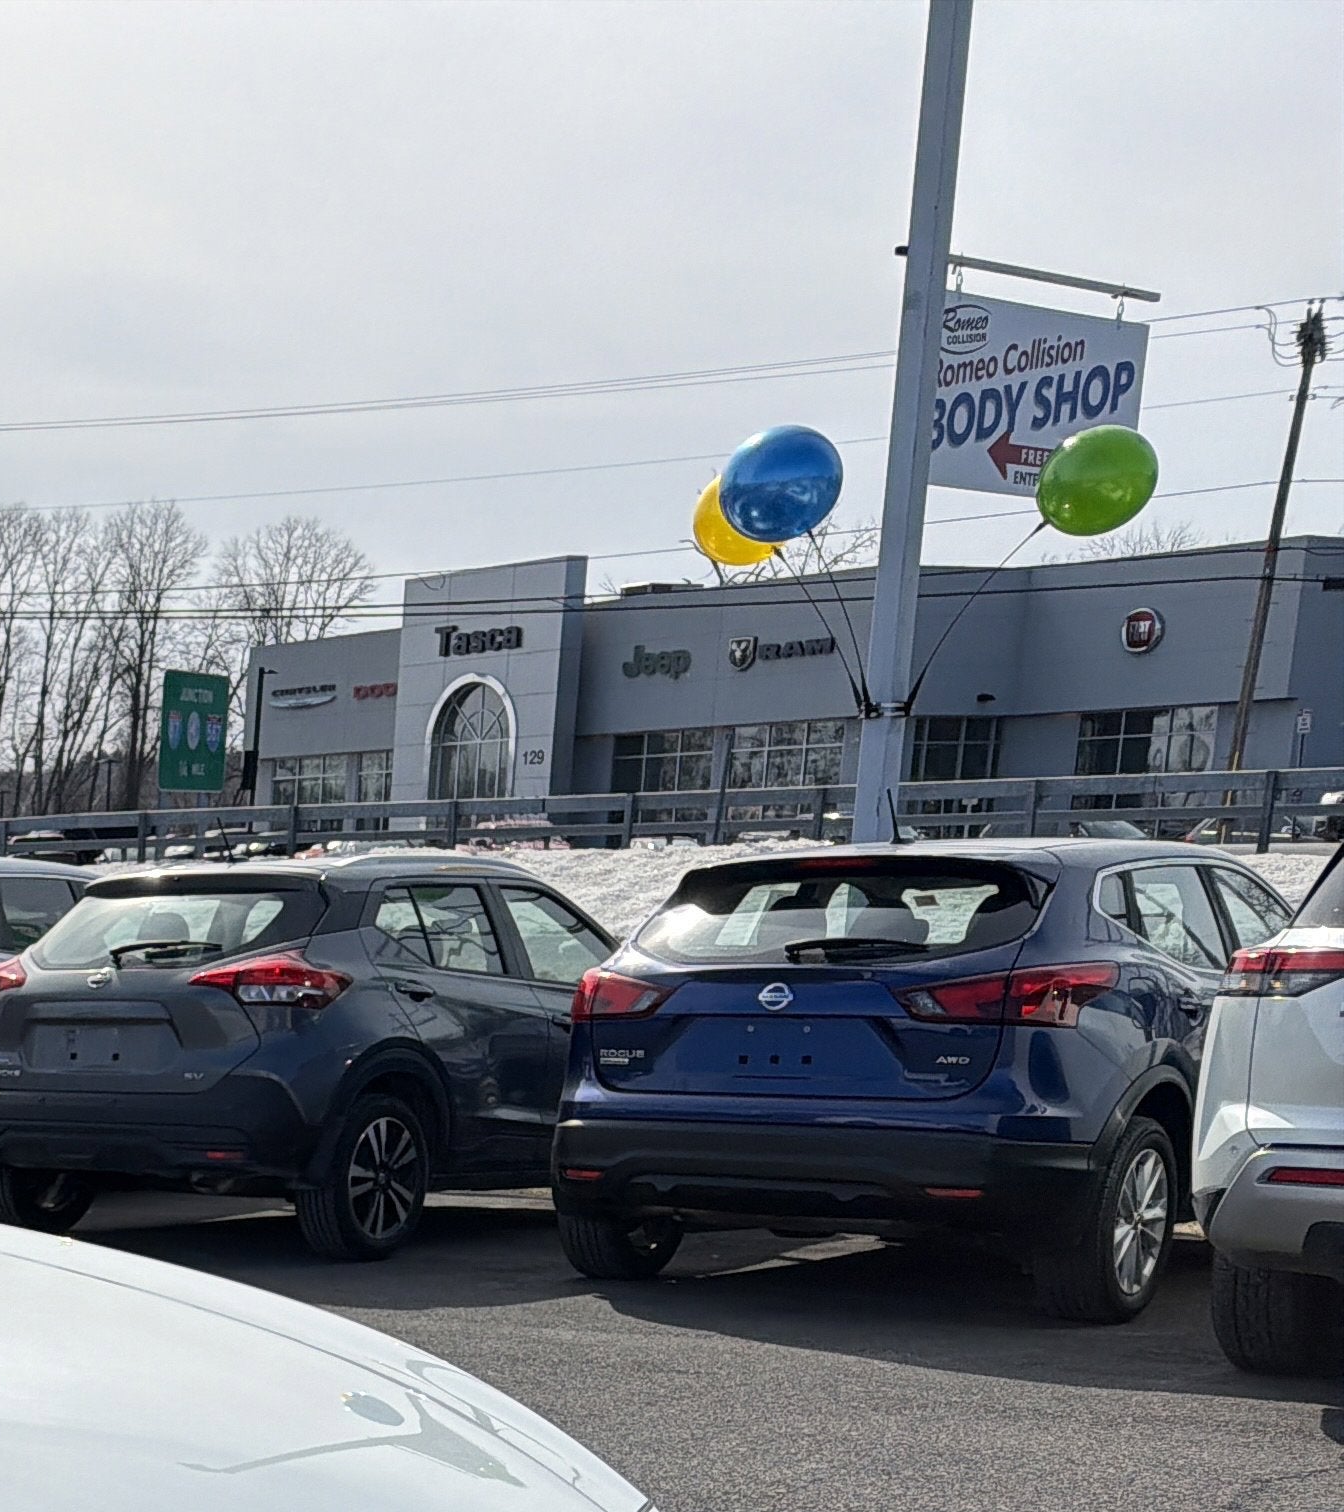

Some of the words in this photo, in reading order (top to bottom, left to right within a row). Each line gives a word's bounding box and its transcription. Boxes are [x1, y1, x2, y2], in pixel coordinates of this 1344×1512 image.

[942, 308, 989, 333] Romeo
[946, 333, 987, 346] COLLISION
[1003, 335, 1085, 376] Collision
[931, 380, 1028, 451] BODY
[1030, 361, 1136, 432] SHOP
[434, 624, 523, 657] Tasca
[758, 636, 836, 661] RAM
[622, 645, 692, 680] Jeep
[353, 682, 397, 700] DOD
[523, 749, 545, 766] 129
[599, 1048, 645, 1059] ROGUE
[935, 1056, 971, 1065] AWD
[183, 1072, 205, 1080] SV
